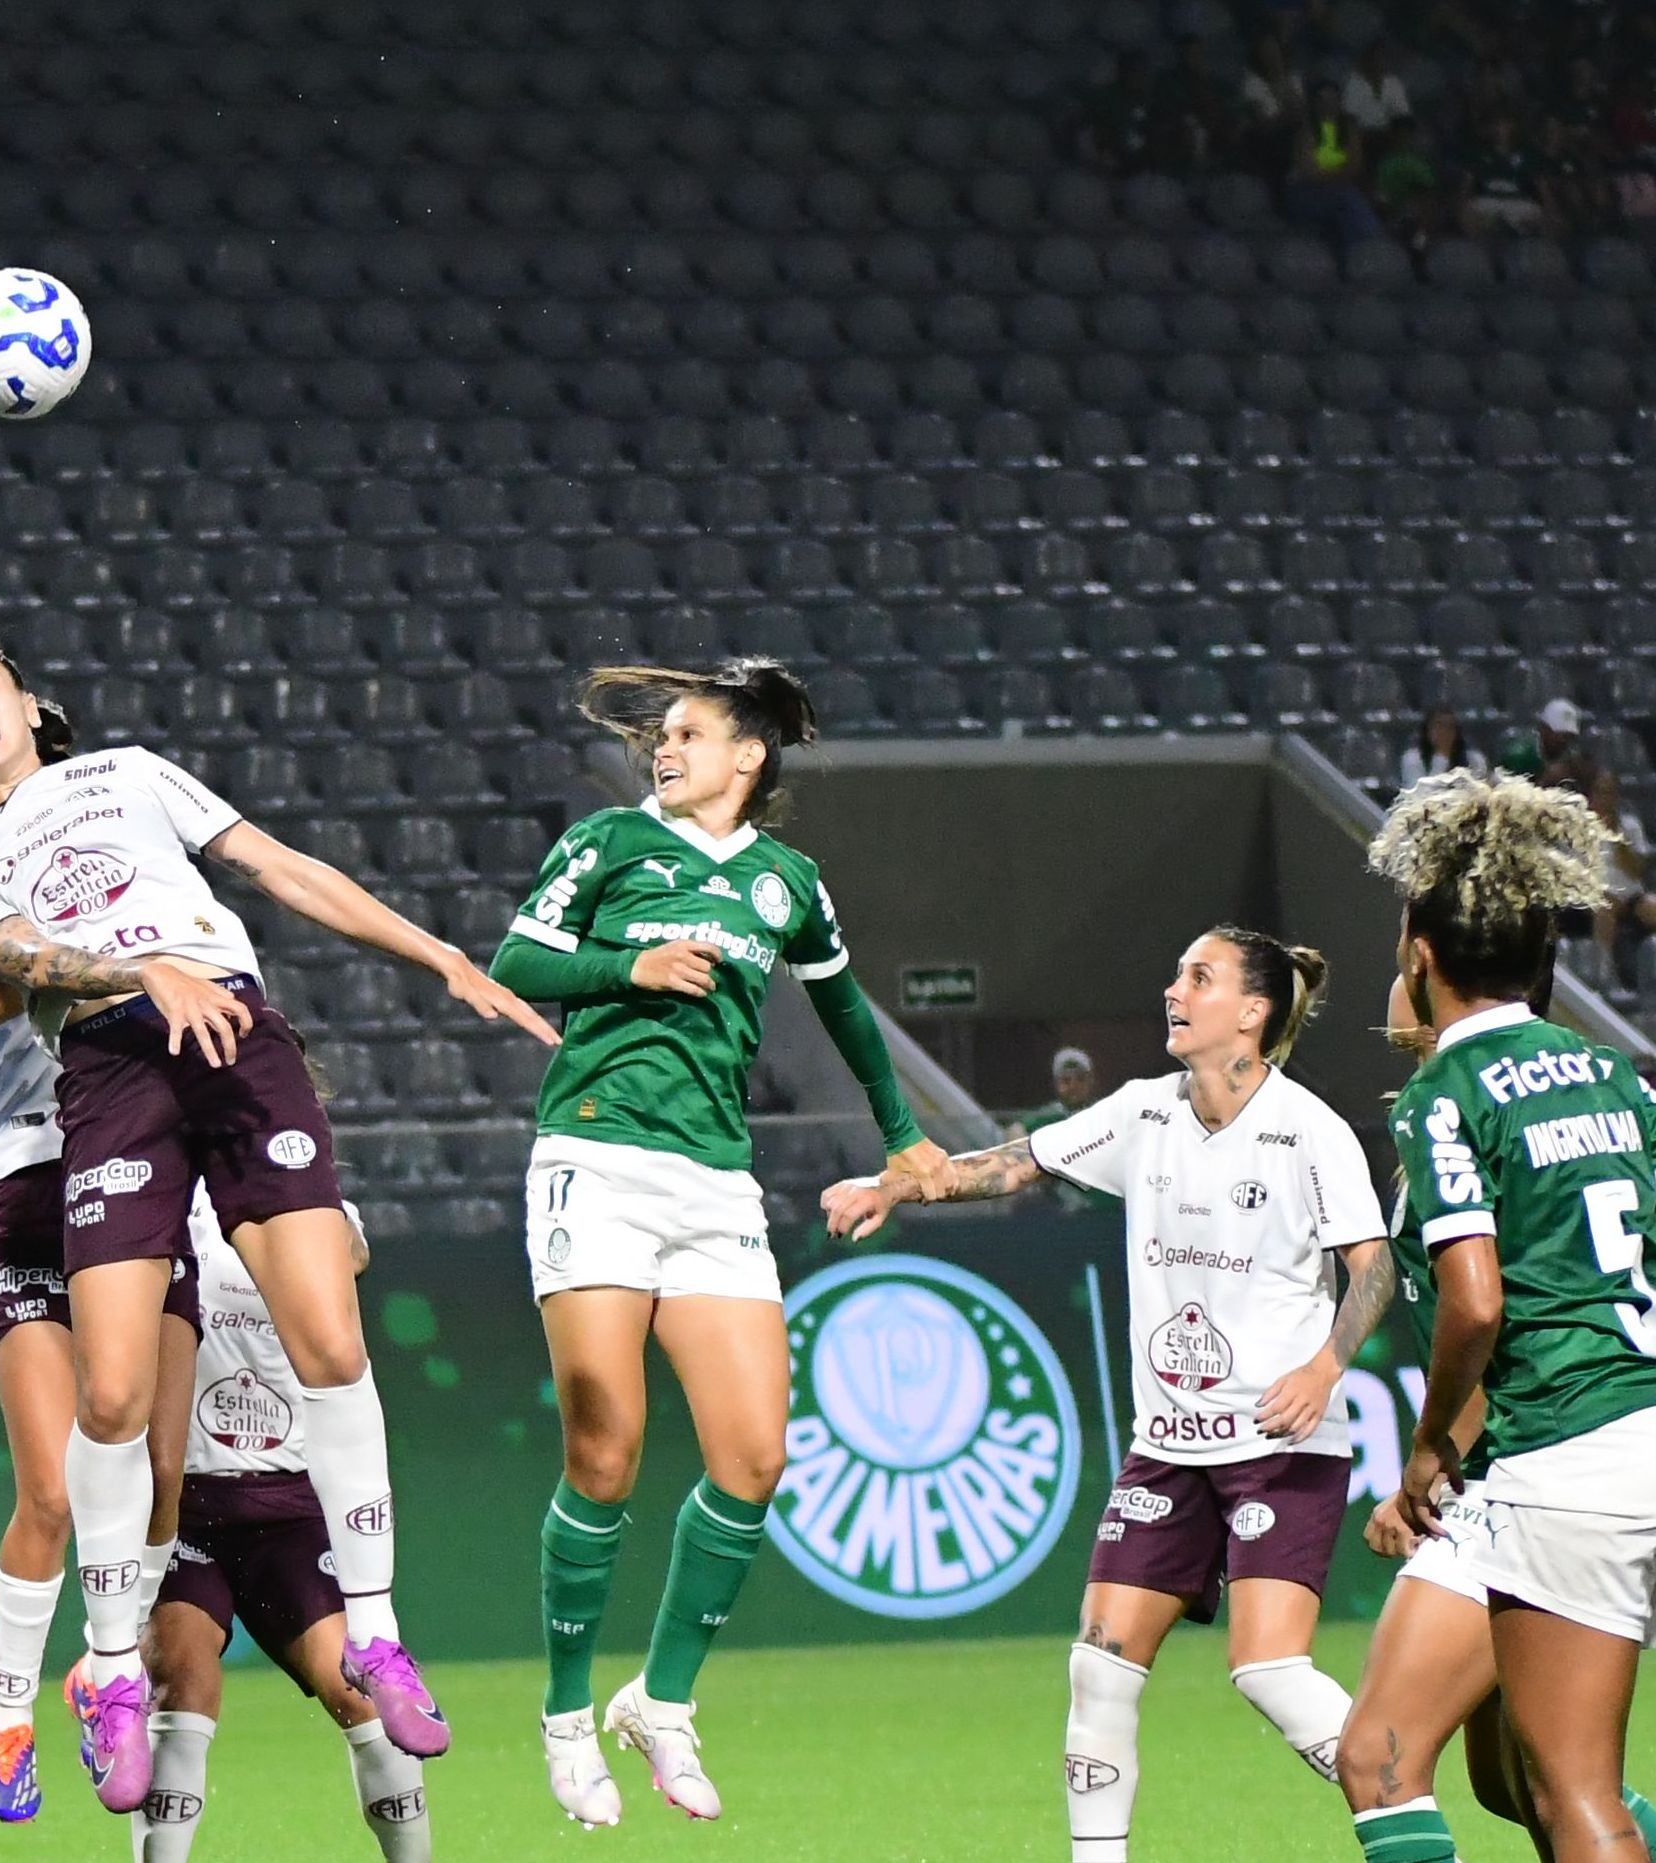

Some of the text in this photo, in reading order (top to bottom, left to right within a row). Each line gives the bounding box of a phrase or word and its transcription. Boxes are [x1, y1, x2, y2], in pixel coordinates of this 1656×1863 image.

[17, 807, 125, 860] galerabet
[625, 921, 777, 974] sportingbet
[80, 1007, 127, 1035] POLO
[1479, 1047, 1596, 1104] Fictor
[273, 1136, 311, 1160] AFE
[1061, 1130, 1115, 1165] Unimed
[548, 1169, 576, 1212] 17
[1232, 1181, 1268, 1209] AFE
[1310, 1166, 1330, 1225] Unimed
[69, 1201, 104, 1225] LUPO
[1165, 1244, 1254, 1274] galerabet
[775, 1408, 1060, 1594] PALMEIRAS
[1236, 1506, 1266, 1531] AFE
[83, 1564, 132, 1593] AFE
[147, 1794, 193, 1819] AFE
